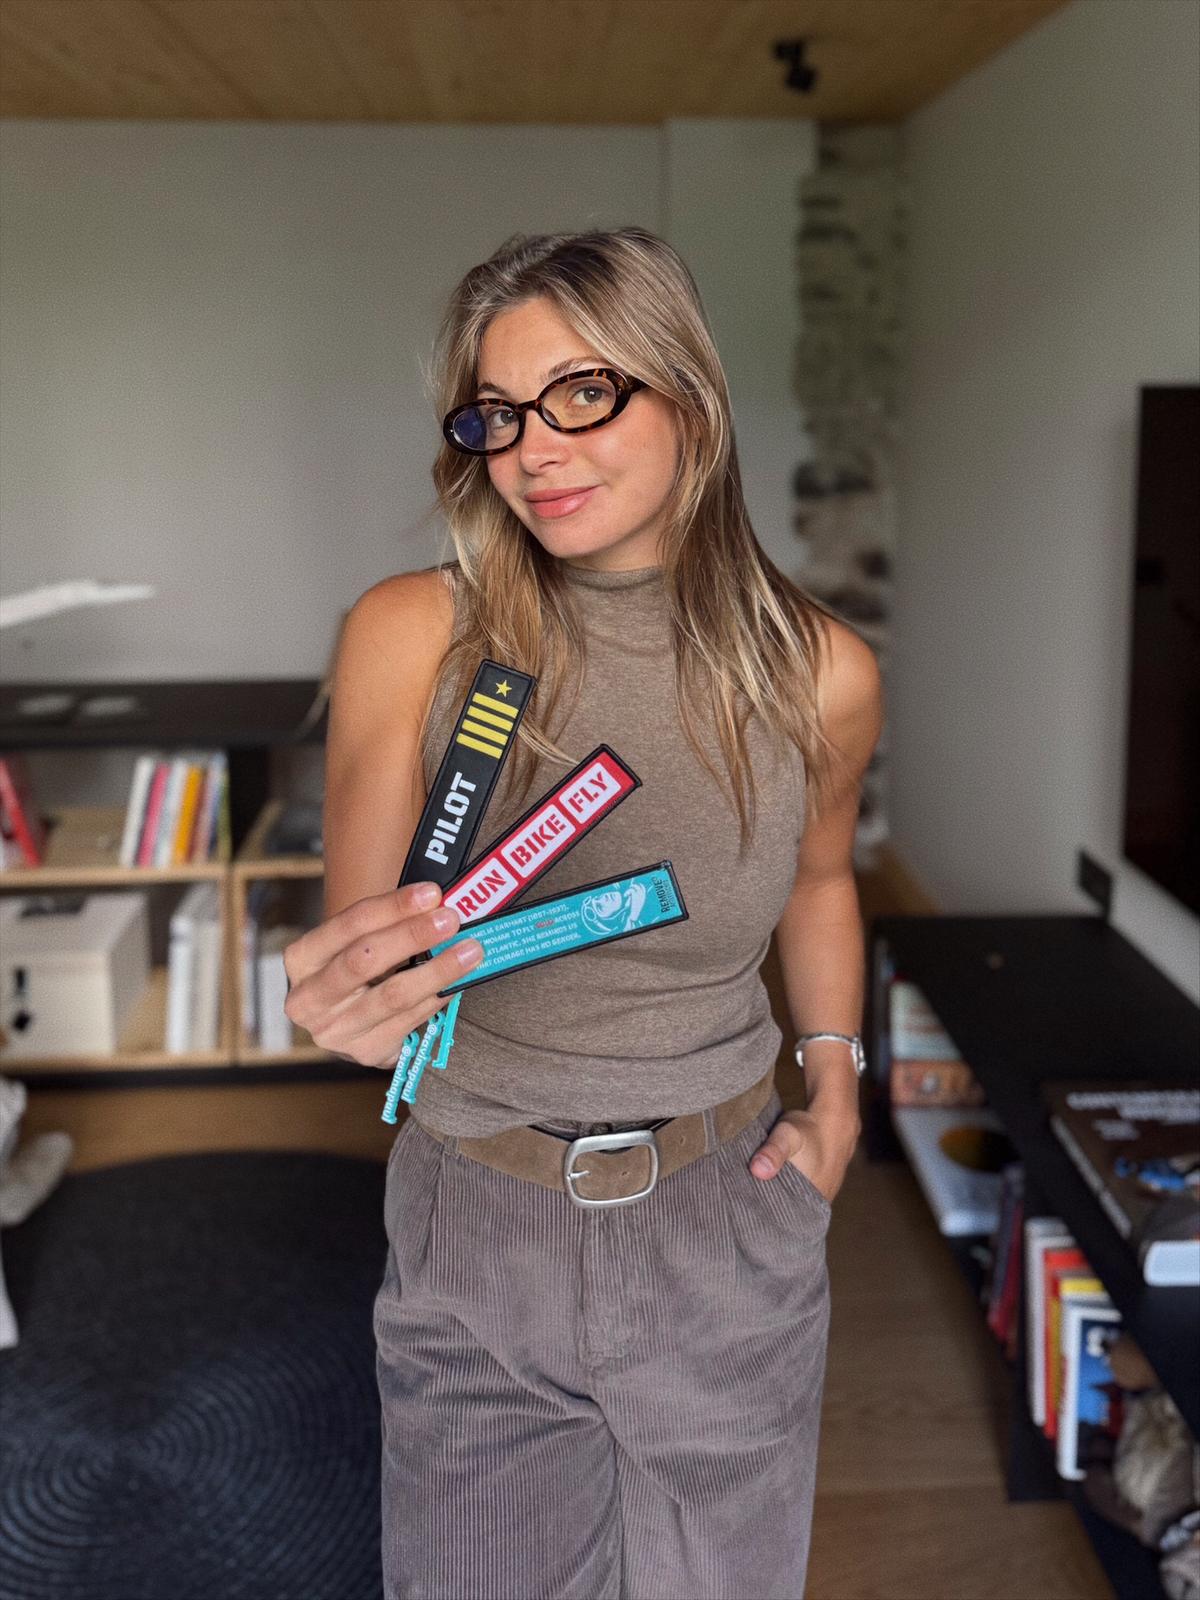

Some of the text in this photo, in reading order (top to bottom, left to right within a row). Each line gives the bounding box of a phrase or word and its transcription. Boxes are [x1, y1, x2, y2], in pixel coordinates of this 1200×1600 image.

[424, 771, 477, 865] PILOT
[455, 771, 609, 918] RUN BIKE FLY
[511, 928, 522, 937] TO
[522, 924, 535, 934] FLY
[521, 935, 536, 945] SHE
[568, 922, 578, 931] US
[525, 944, 540, 955] HAS
[540, 940, 552, 949] NO
